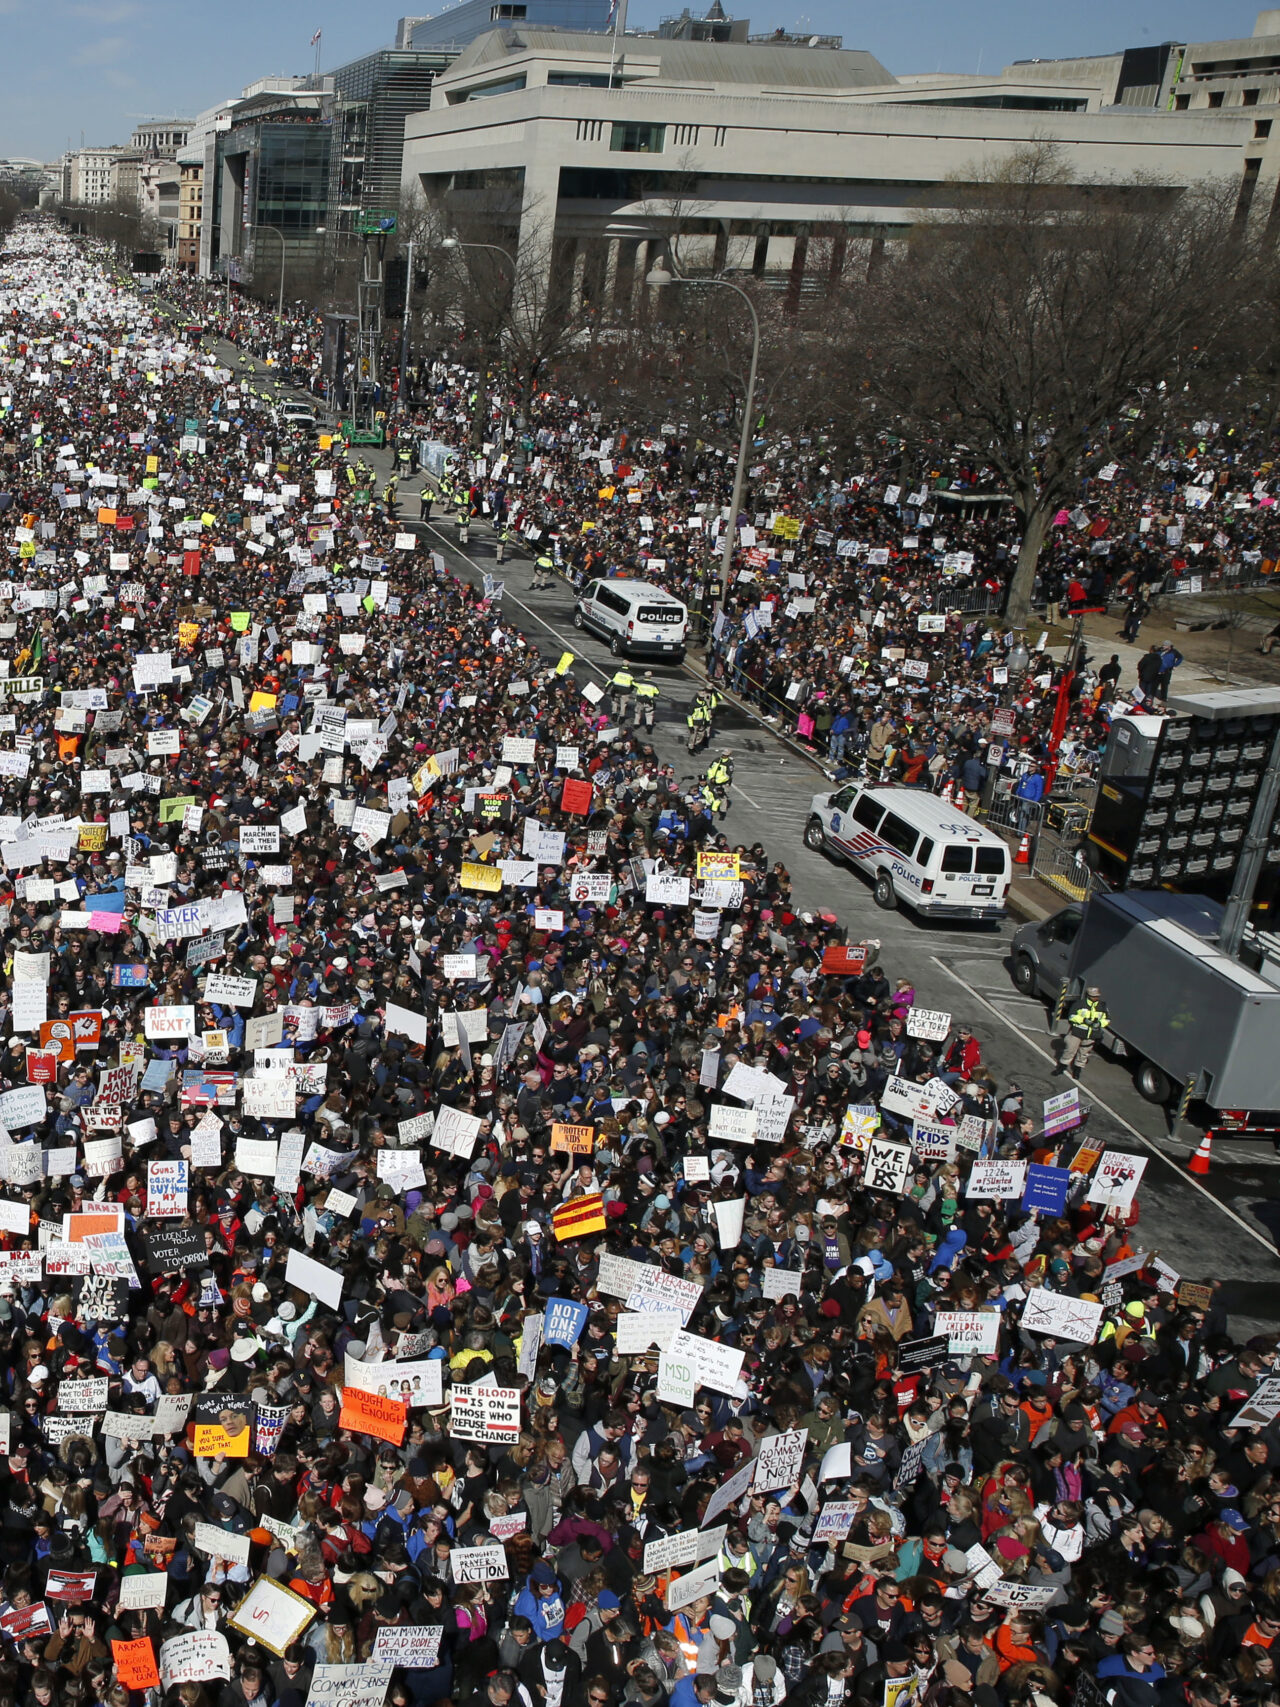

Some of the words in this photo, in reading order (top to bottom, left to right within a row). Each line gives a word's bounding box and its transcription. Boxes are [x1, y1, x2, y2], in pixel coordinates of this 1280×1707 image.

[591, 610, 605, 624] POLICE
[4, 679, 41, 695] MILLS
[939, 824, 982, 836] 995
[700, 853, 737, 864] Protect
[700, 867, 736, 877] Future
[891, 862, 920, 887] POLICE
[728, 897, 741, 908] BS
[157, 907, 199, 924] NEVER
[157, 921, 202, 938] AGAIN
[150, 1008, 167, 1019] AM
[108, 1064, 134, 1082] HOW
[103, 1075, 133, 1093] MANY
[98, 1083, 137, 1103] MORE?
[889, 1085, 909, 1097] GUNS
[87, 1117, 96, 1125] IS
[101, 1117, 121, 1125] NOW
[400, 1114, 431, 1130] HISTORY
[917, 1124, 954, 1135] PROTECT
[844, 1133, 863, 1147] BS
[916, 1130, 949, 1145] KIDS
[873, 1145, 904, 1163] WE
[915, 1147, 947, 1157] GUNS
[151, 1162, 174, 1175] Guns
[871, 1157, 904, 1173] CALL
[872, 1169, 897, 1190] BS
[1103, 1166, 1135, 1180] OVER
[150, 1184, 168, 1194] BUY
[149, 1202, 187, 1216] Education
[149, 1230, 188, 1243] STUDENT
[10, 1251, 30, 1260] NRA
[153, 1249, 180, 1258] VOTER
[164, 1253, 208, 1267] TOMORROW
[47, 1263, 70, 1273] NOT
[641, 1268, 701, 1294] #NEVERAGAIN
[553, 1304, 580, 1320] NOT
[550, 1316, 576, 1330] ONE
[946, 1322, 983, 1330] CHILDREN
[548, 1327, 573, 1344] MORE
[949, 1332, 962, 1340] NOT
[964, 1332, 982, 1341] GUNS
[1061, 1324, 1090, 1341] AFRAID
[666, 1363, 690, 1382] MSD
[93, 1388, 105, 1396] FOR
[342, 1388, 382, 1407] ENOUGH
[454, 1386, 472, 1395] THE
[478, 1389, 516, 1399] BLOOD
[165, 1396, 185, 1404] FEAR
[470, 1399, 483, 1407] IS
[489, 1400, 505, 1409] ON
[176, 1404, 188, 1412] NO
[361, 1404, 404, 1424] ENOUGH
[455, 1407, 485, 1419] THOSE
[490, 1412, 512, 1421] WHO
[452, 1418, 485, 1429] REFUSE
[475, 1431, 517, 1442] CHANGE
[760, 1443, 805, 1460] COMMON
[762, 1454, 799, 1469] SENSE
[766, 1464, 797, 1479] NOT
[753, 1473, 801, 1491] POLITICS
[460, 1566, 505, 1581] ACTION
[997, 1581, 1013, 1589] YOU
[123, 1595, 161, 1606] BULLETS
[1010, 1590, 1029, 1601] US
[378, 1627, 398, 1637] HOW
[400, 1627, 424, 1636] MANY
[117, 1642, 146, 1651] ARMS
[378, 1638, 409, 1648] DEAD
[410, 1638, 439, 1647] BODIES
[404, 1648, 438, 1656] CONGRESS
[345, 1666, 391, 1676] WISH
[311, 1680, 358, 1692] COMMON
[359, 1678, 389, 1687] SENSE
